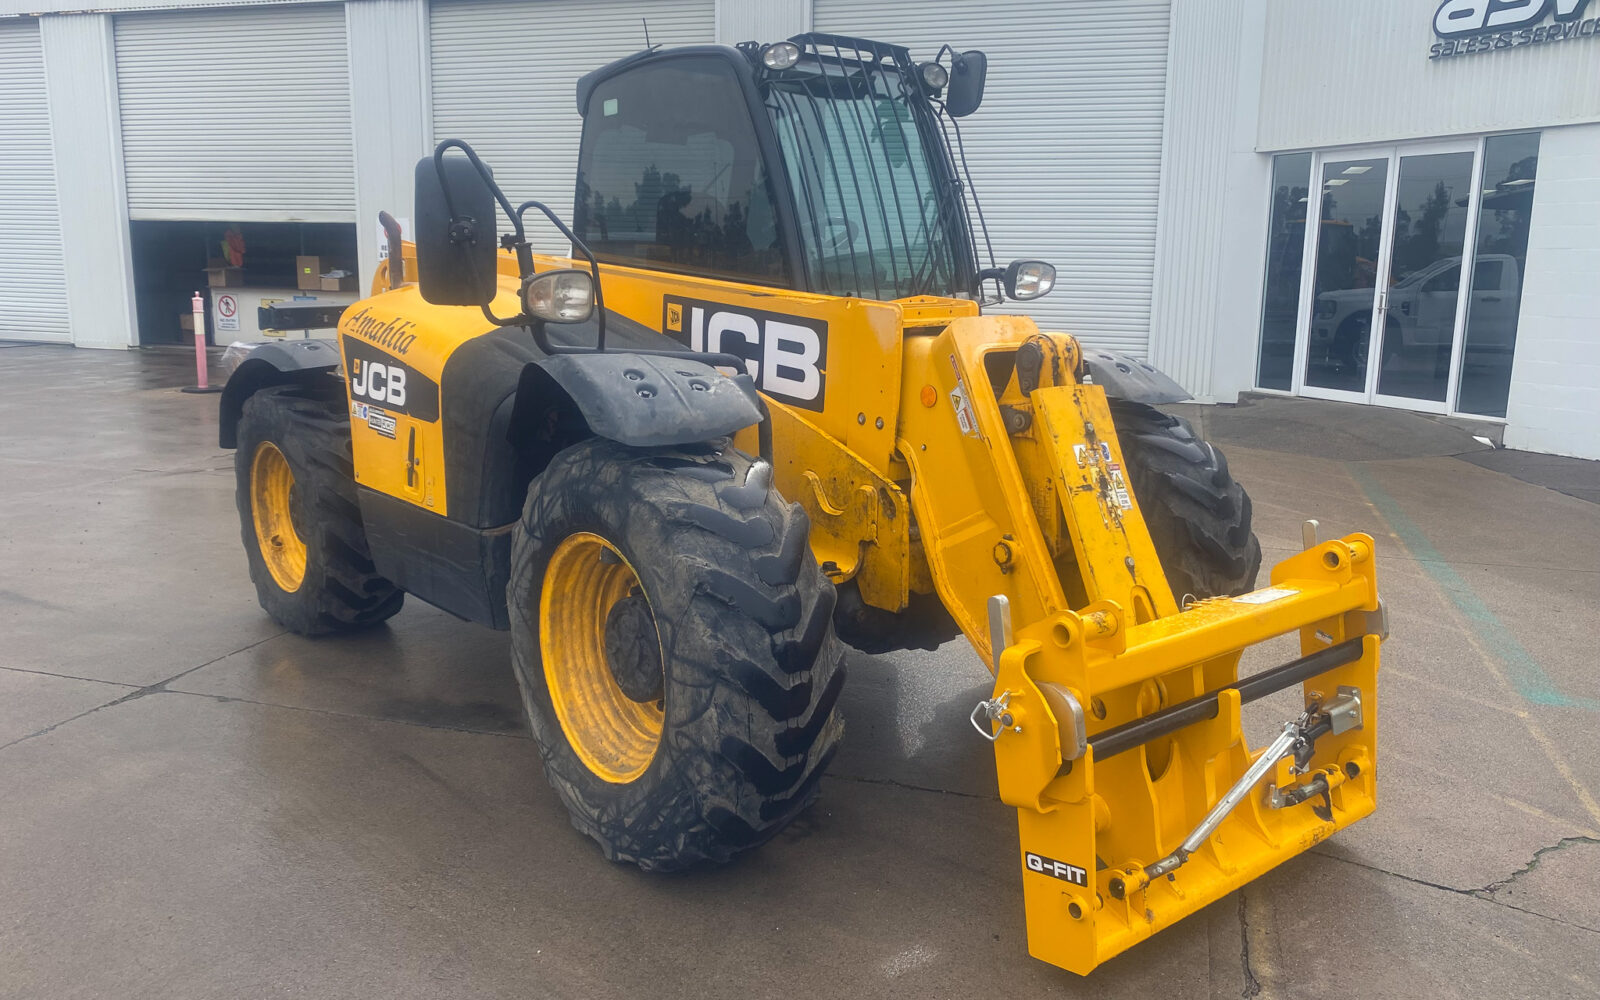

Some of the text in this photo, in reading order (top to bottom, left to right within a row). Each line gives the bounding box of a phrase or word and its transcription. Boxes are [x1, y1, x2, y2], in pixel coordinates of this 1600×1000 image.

[1495, 33, 1513, 49] &
[352, 360, 406, 406] JCB
[1026, 853, 1086, 884] Q-FIT
